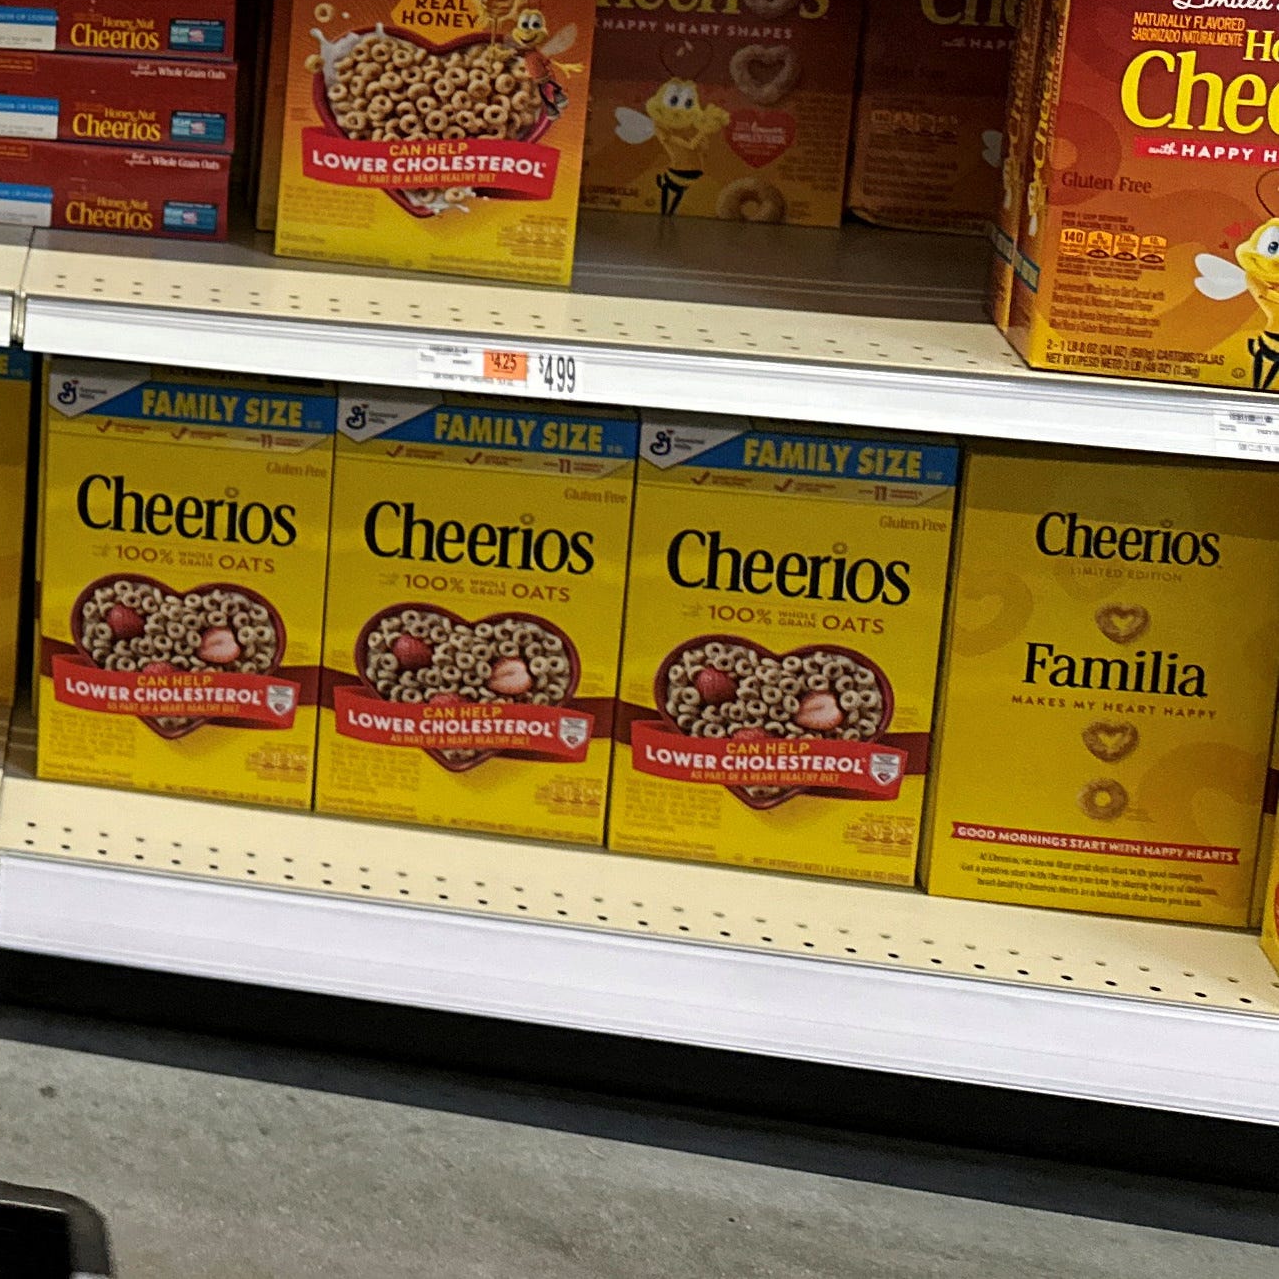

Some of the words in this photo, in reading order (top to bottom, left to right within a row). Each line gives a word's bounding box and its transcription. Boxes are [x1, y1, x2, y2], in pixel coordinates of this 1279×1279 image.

[402, 11, 479, 29] HONEY
[1133, 12, 1191, 29] NATURALLY
[1194, 16, 1246, 31] FLAVORED
[312, 150, 388, 172] LOWER
[142, 389, 239, 421] FAMILY
[245, 400, 302, 427] SIZE
[743, 438, 851, 473] FAMILY
[857, 448, 922, 479] SIZE
[76, 474, 297, 547] Cheerios
[218, 554, 276, 574] OATS
[512, 582, 571, 603] OATS
[708, 604, 772, 626] 100%
[822, 615, 885, 636] OATS
[1021, 642, 1208, 698] Familia
[1011, 695, 1066, 710] MAKES
[1072, 700, 1097, 711] MY
[1103, 702, 1158, 716] HEART
[1163, 707, 1217, 720] HAPPY
